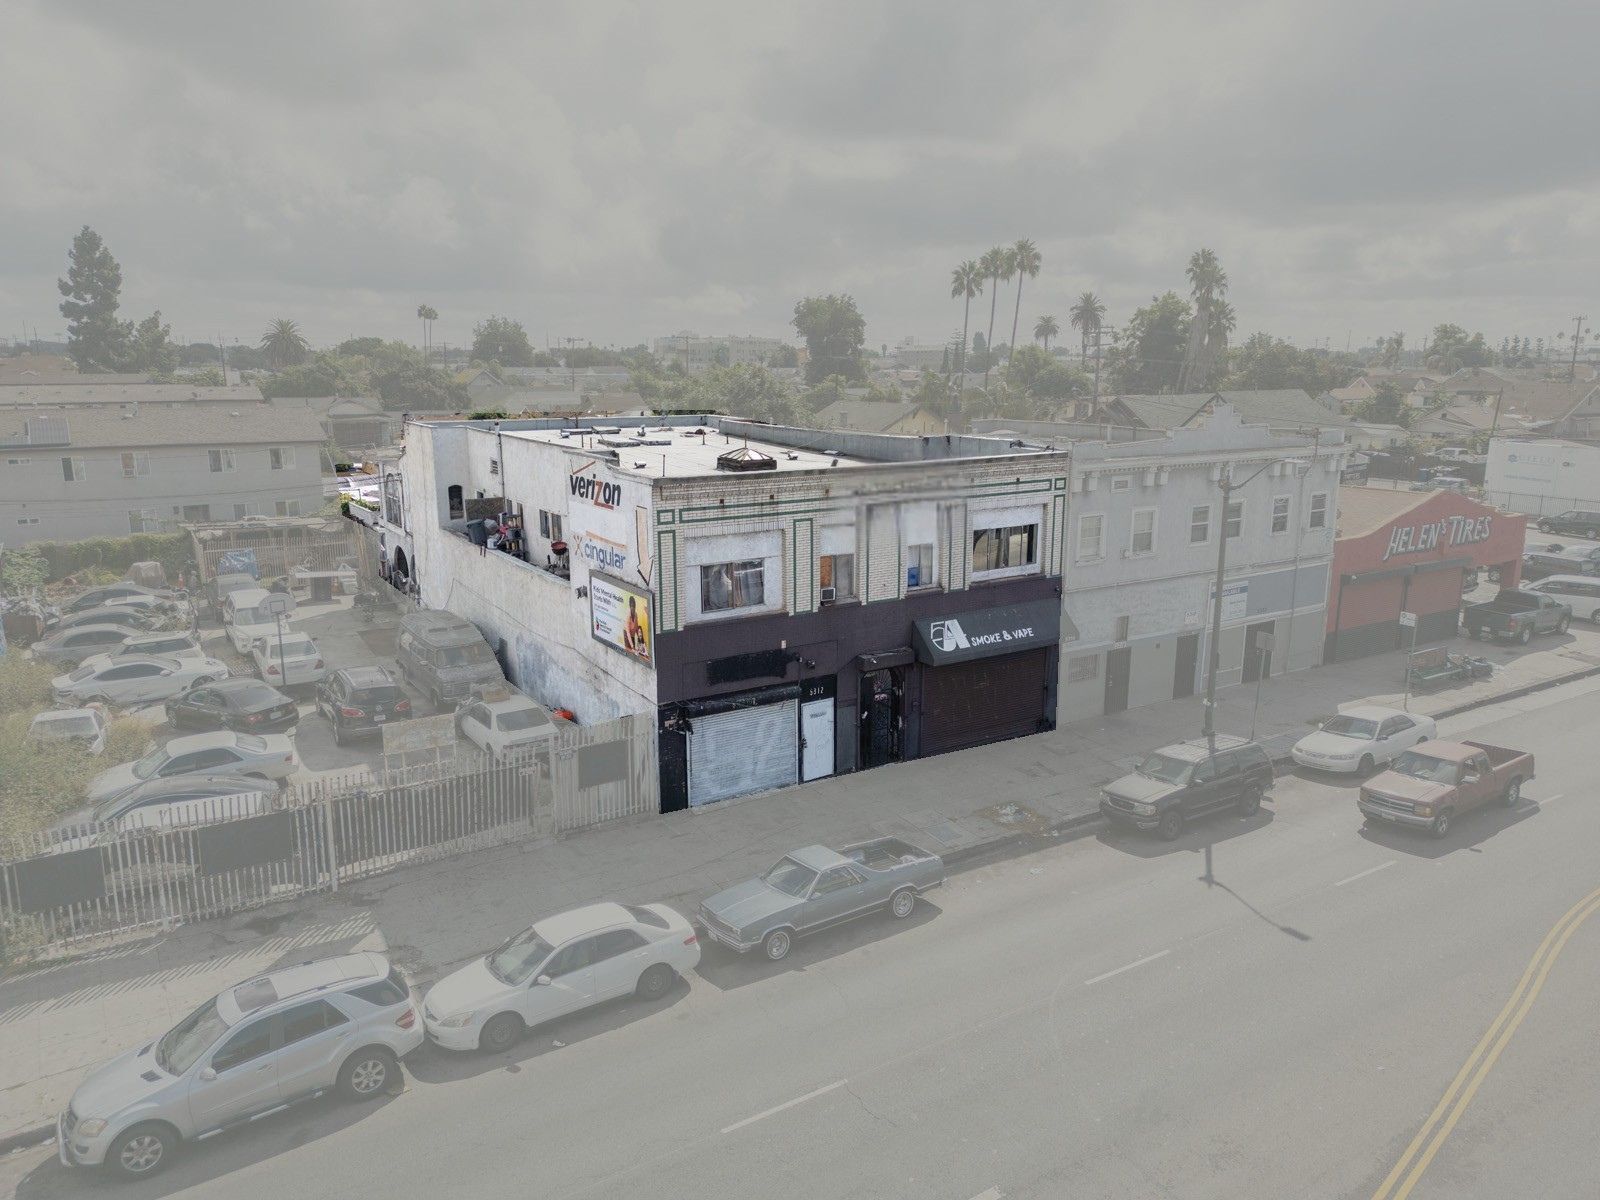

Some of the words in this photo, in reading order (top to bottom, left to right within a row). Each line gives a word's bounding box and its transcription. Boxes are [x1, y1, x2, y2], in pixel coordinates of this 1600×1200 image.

[570, 474, 621, 510] verizon
[1448, 515, 1492, 546] TIRES
[585, 540, 626, 570] cingular
[971, 632, 1002, 647] SMOKE
[1002, 630, 1013, 641] &
[1012, 627, 1034, 639] VAPE
